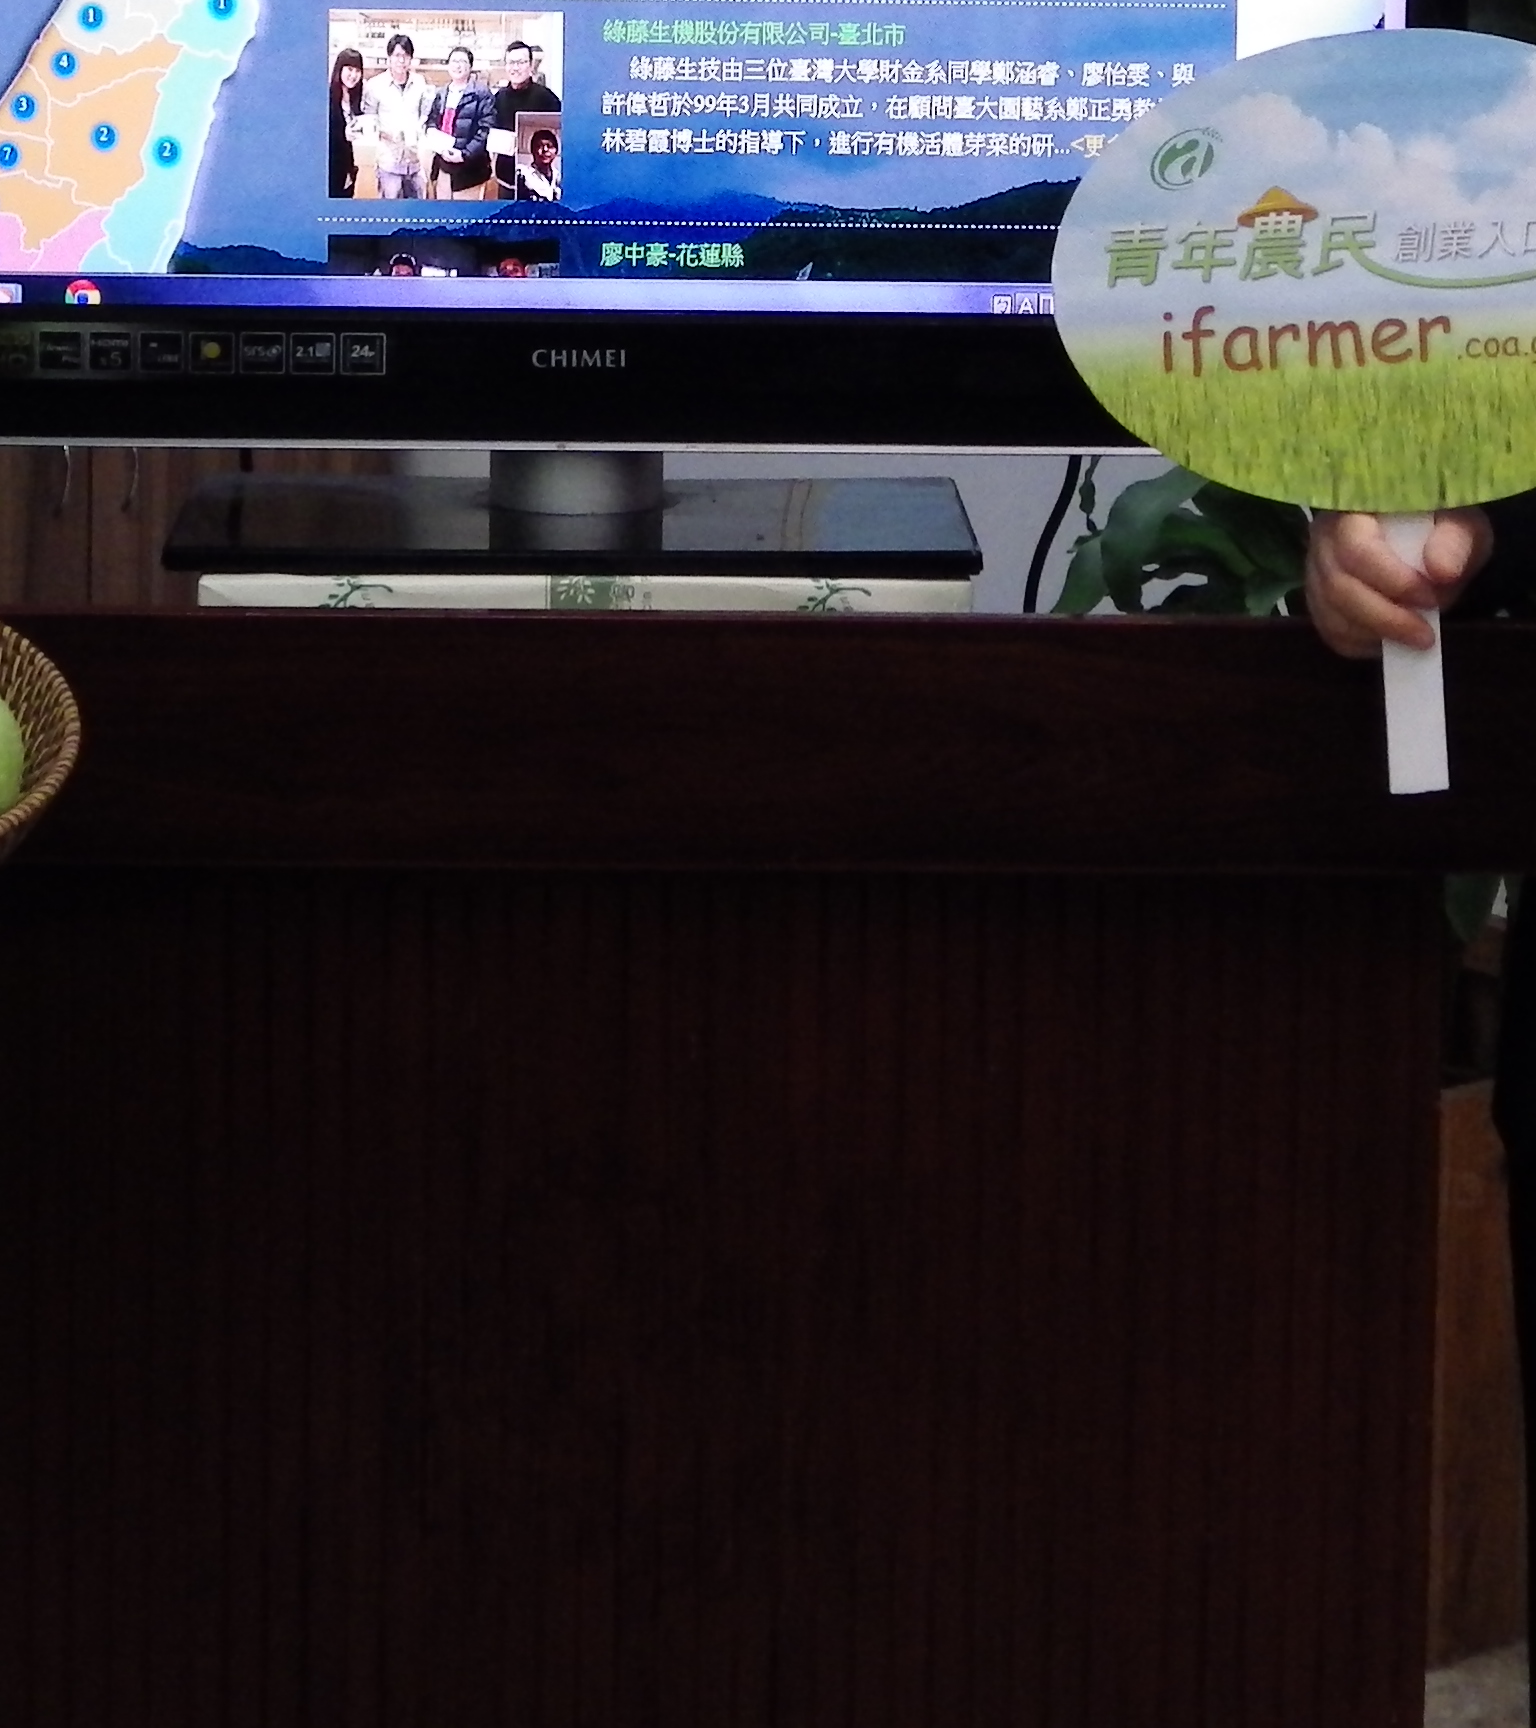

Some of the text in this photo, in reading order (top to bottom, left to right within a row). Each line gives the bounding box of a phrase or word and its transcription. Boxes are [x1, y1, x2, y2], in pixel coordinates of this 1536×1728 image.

[602, 19, 906, 47] 綠藤生機股份有限公司-臺北市
[600, 243, 744, 268] 廖中豪-花蓮縣
[1105, 210, 1377, 288] 青年農民
[531, 349, 628, 369] CHIMEI
